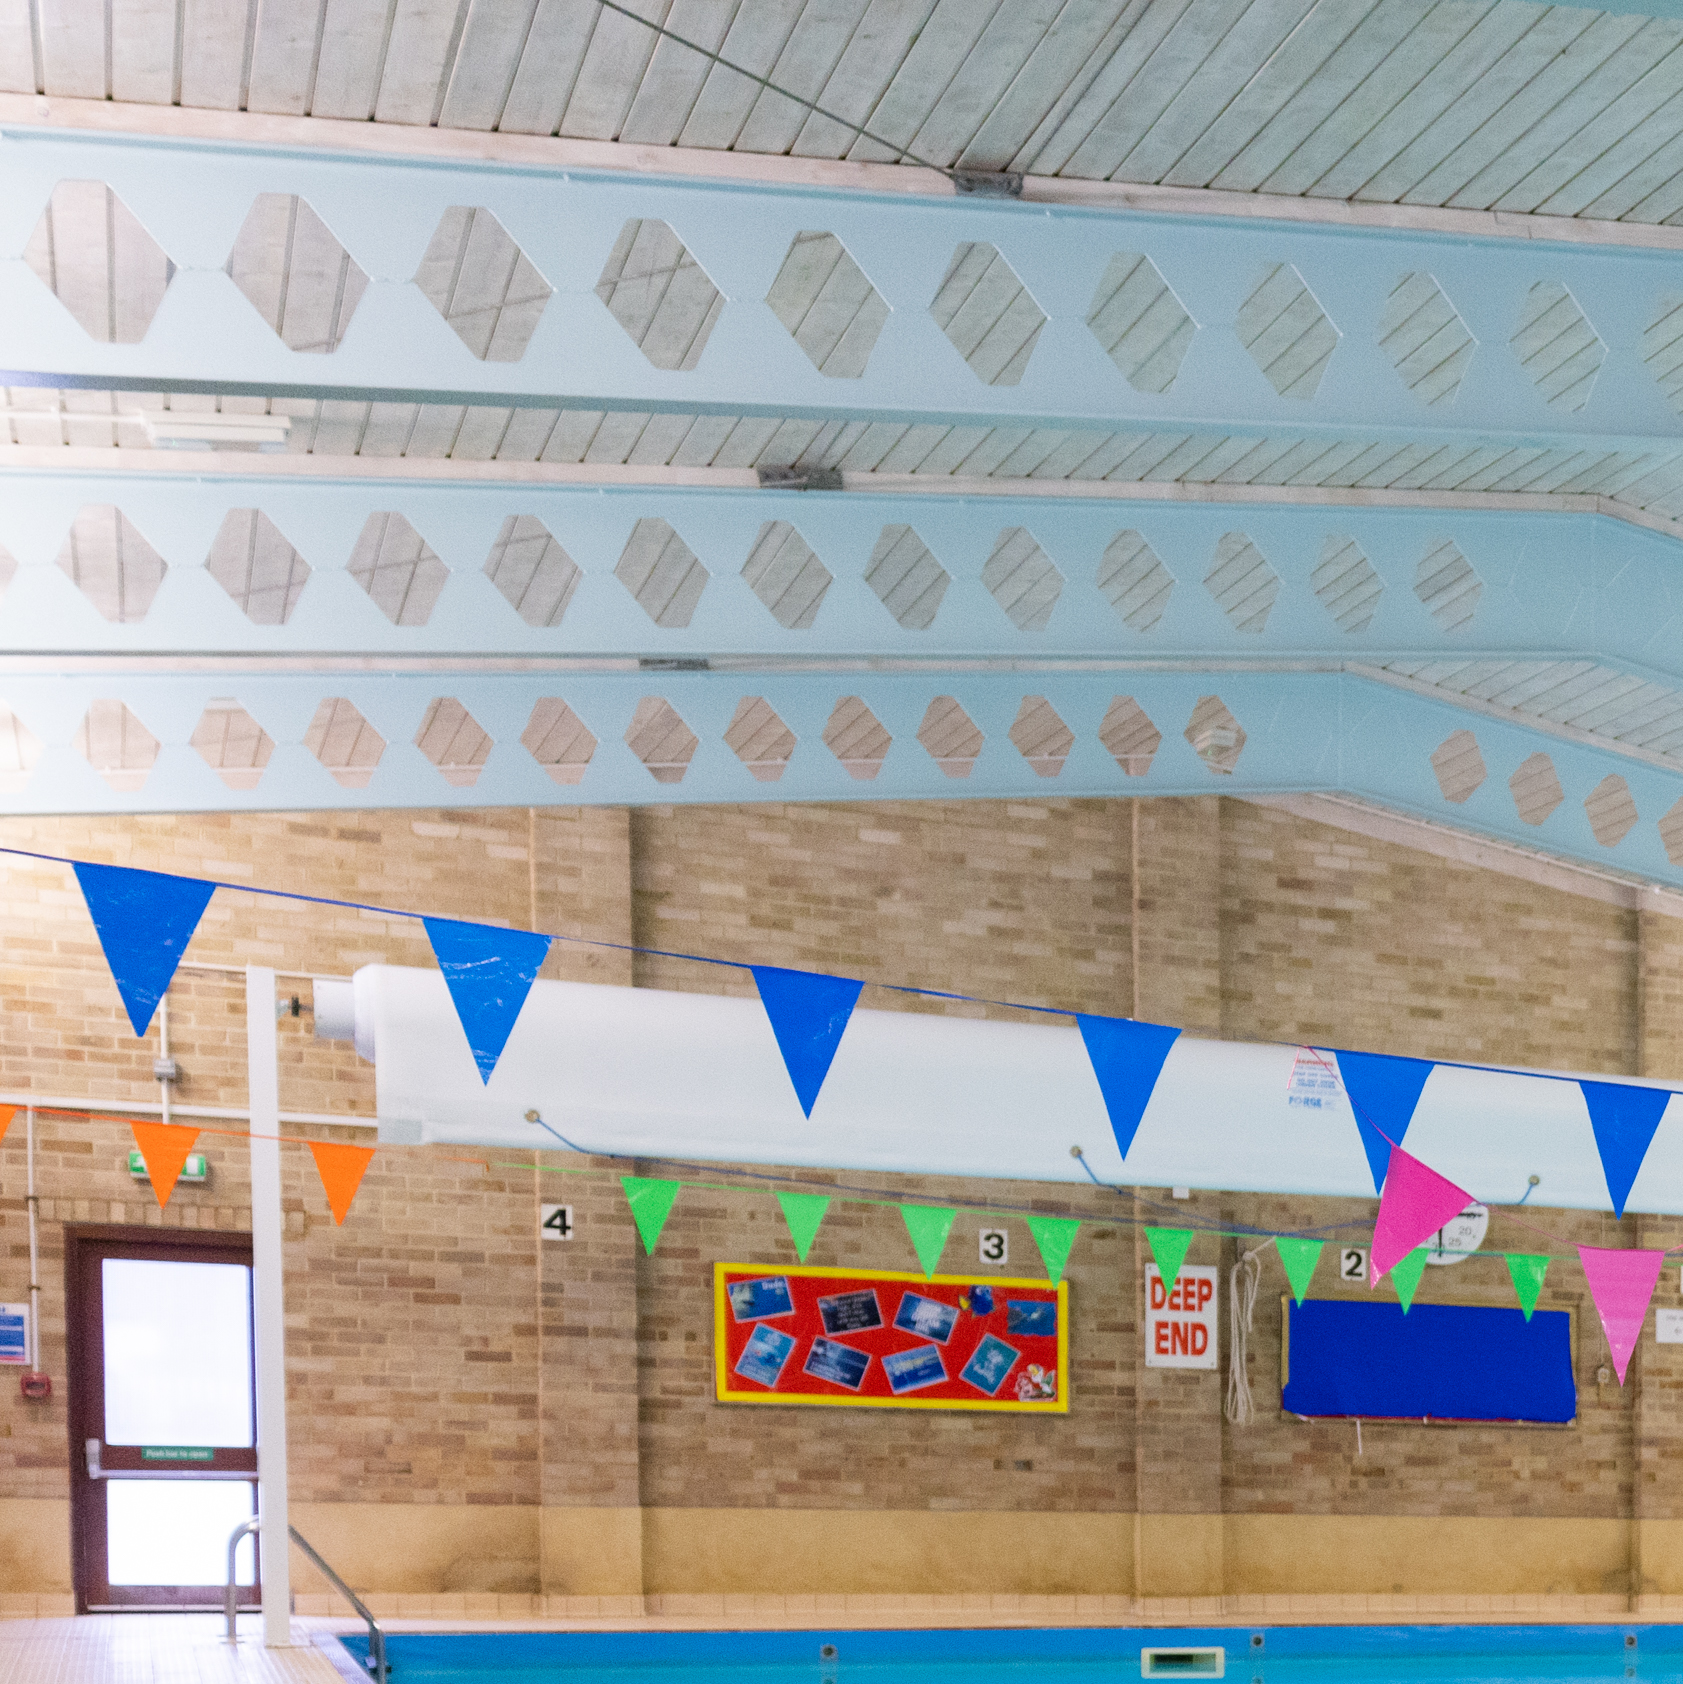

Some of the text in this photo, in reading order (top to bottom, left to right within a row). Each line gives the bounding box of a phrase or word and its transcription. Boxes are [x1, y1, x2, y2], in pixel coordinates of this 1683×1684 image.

[543, 1209, 571, 1235] 4
[983, 1233, 1004, 1259] 3
[1345, 1251, 1363, 1277] 2
[1150, 1276, 1213, 1312] DEEP
[1155, 1321, 1208, 1356] END
